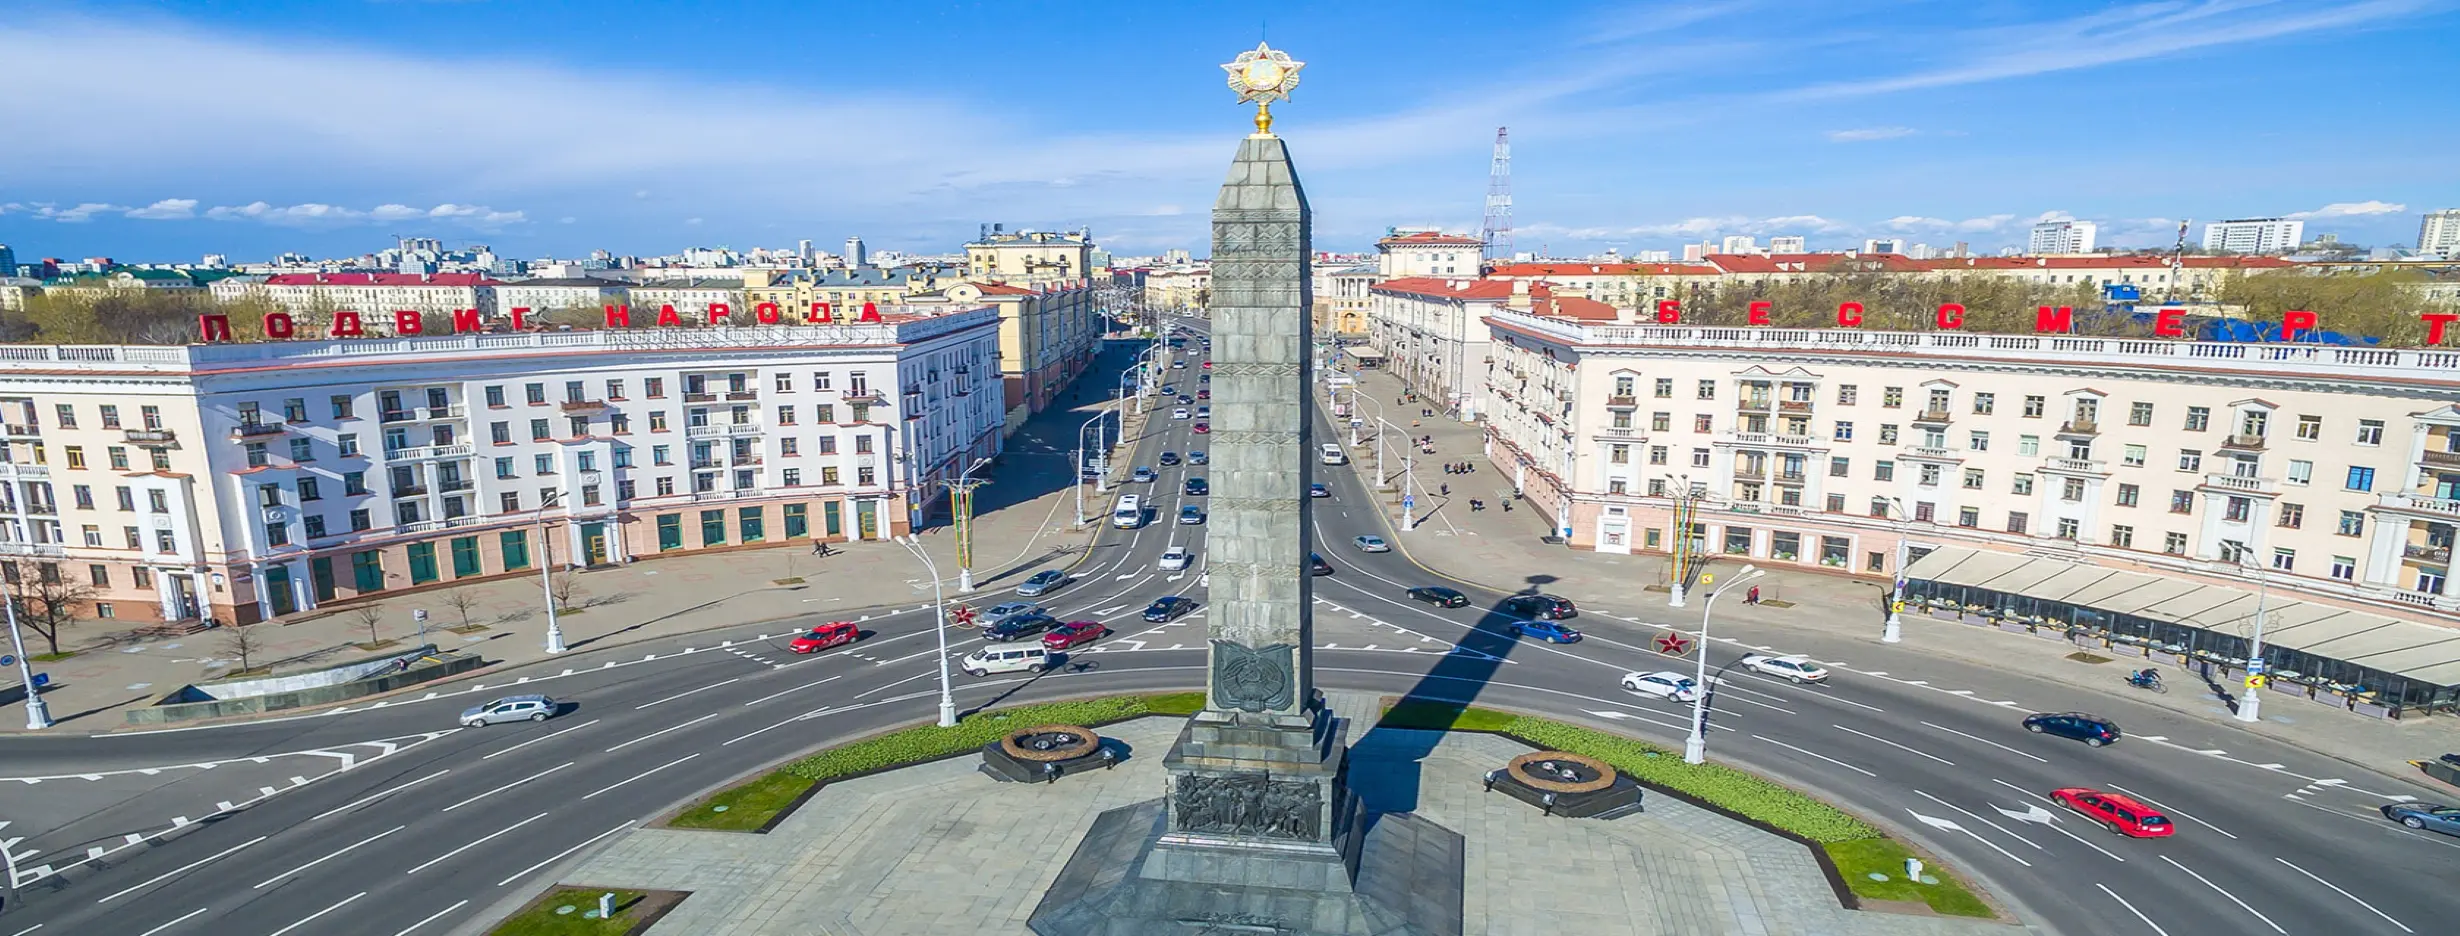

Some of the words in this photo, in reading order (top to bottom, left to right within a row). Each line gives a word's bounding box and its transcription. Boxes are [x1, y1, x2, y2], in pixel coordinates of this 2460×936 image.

[200, 307, 531, 341] ПОДВИГ
[604, 302, 882, 328] НАРОДА
[1657, 300, 2459, 345] БЕССМЕРТ
